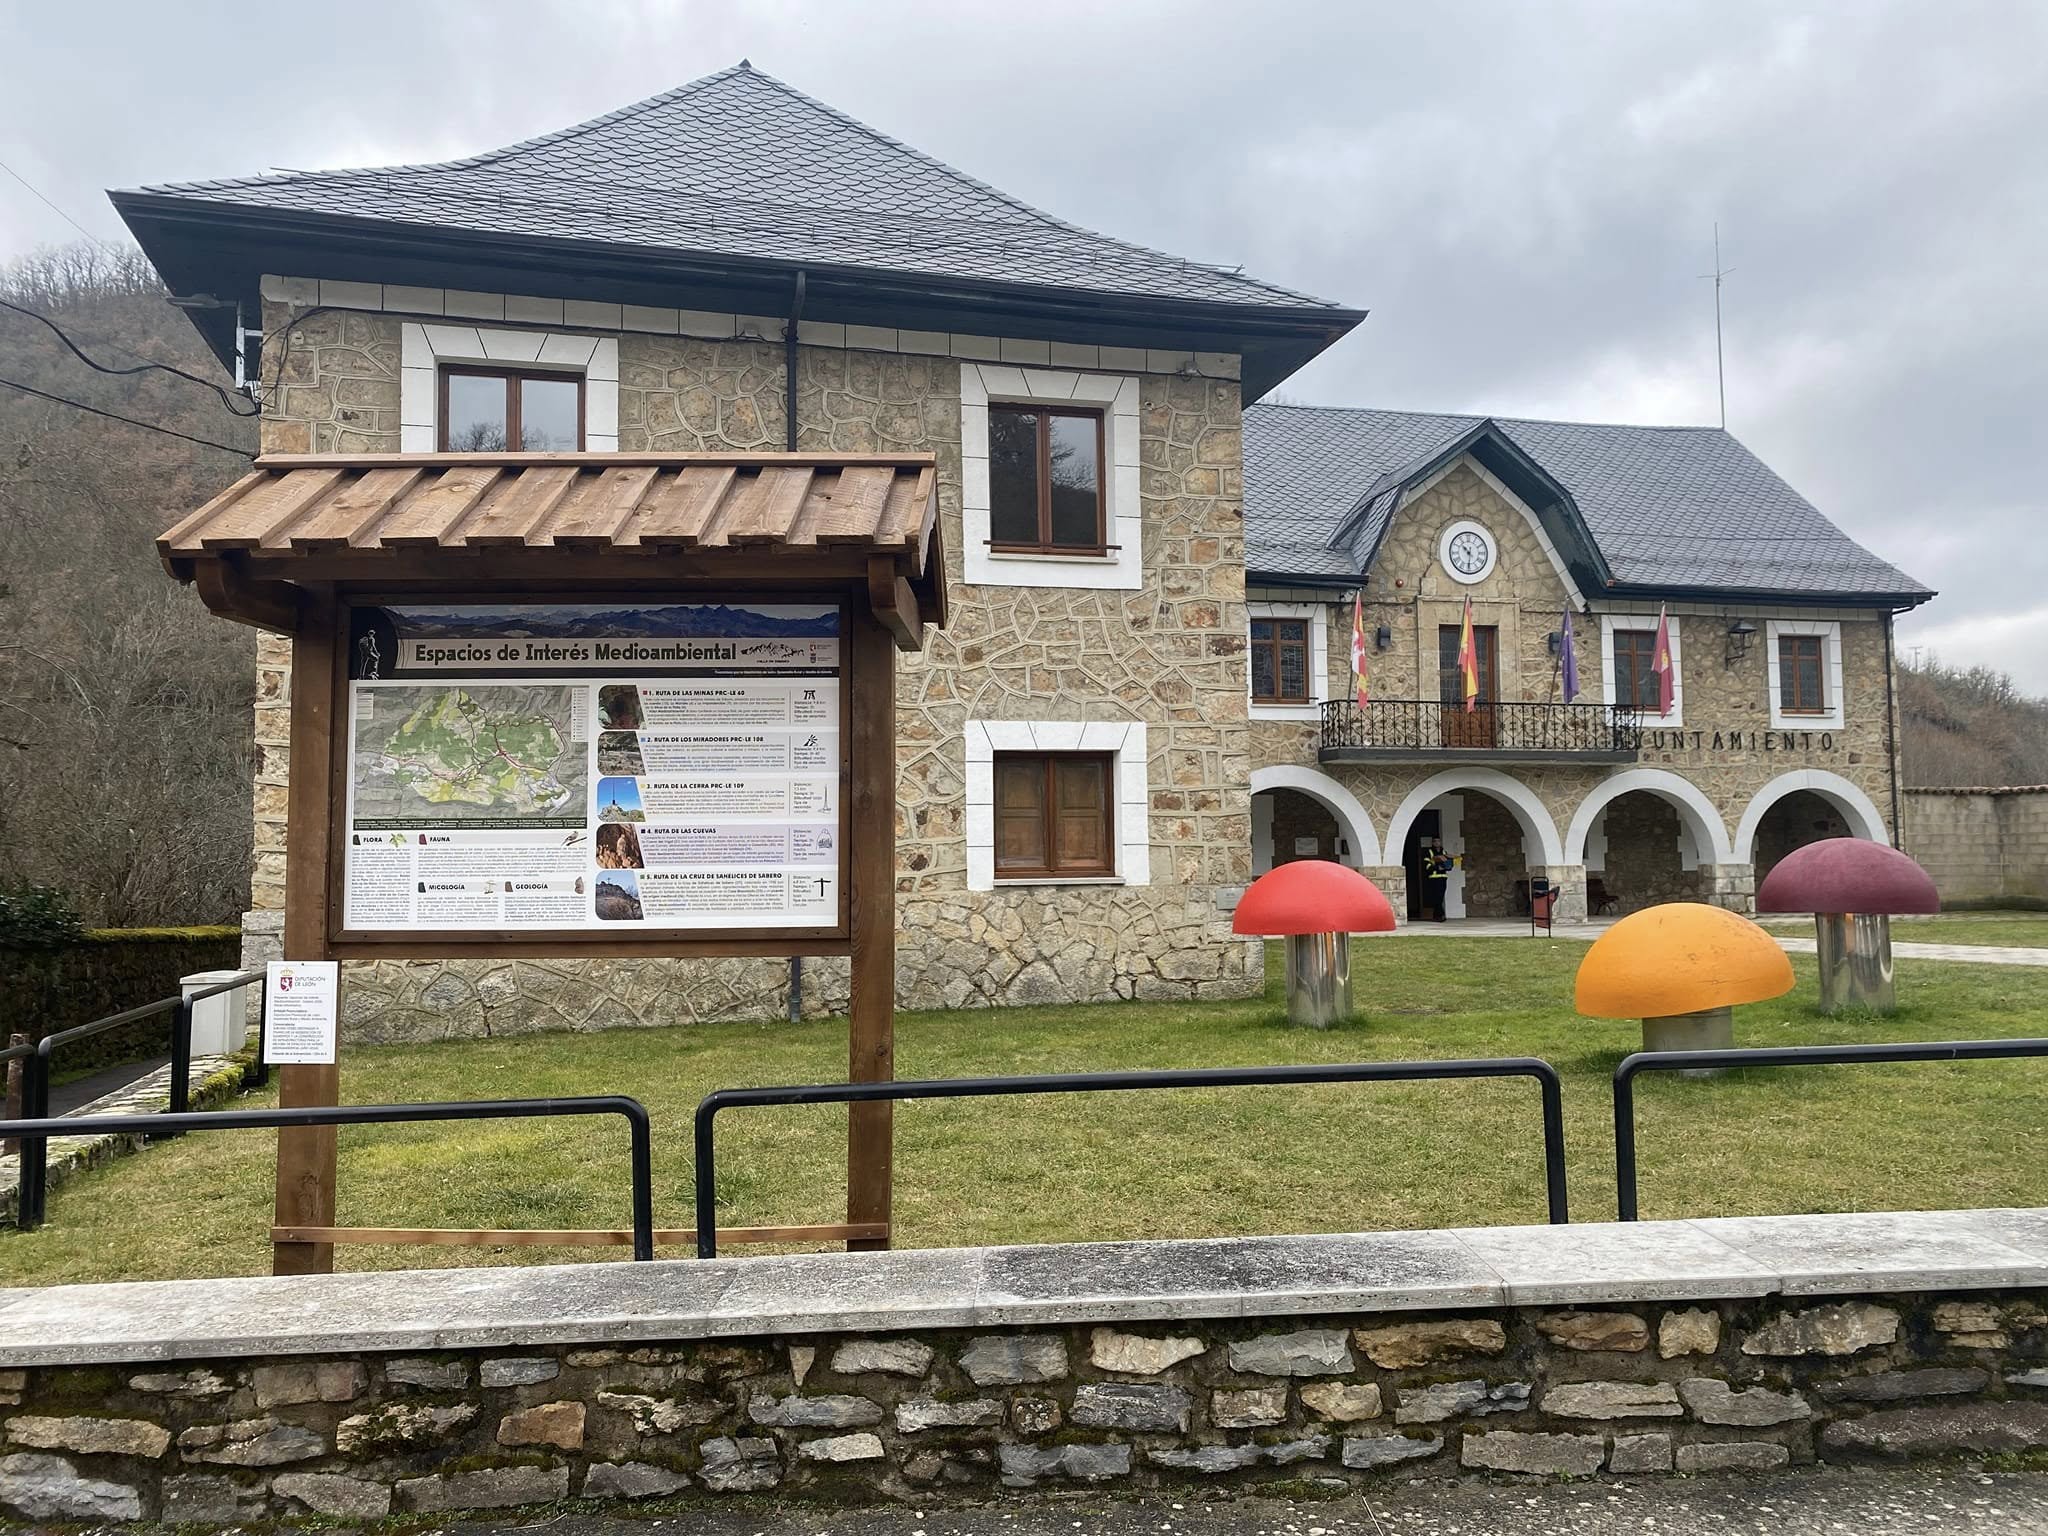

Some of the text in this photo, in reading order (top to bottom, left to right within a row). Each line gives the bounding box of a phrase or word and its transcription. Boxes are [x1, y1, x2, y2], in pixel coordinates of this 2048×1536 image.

[415, 642, 736, 665] Espacios de Interés Medioambiental
